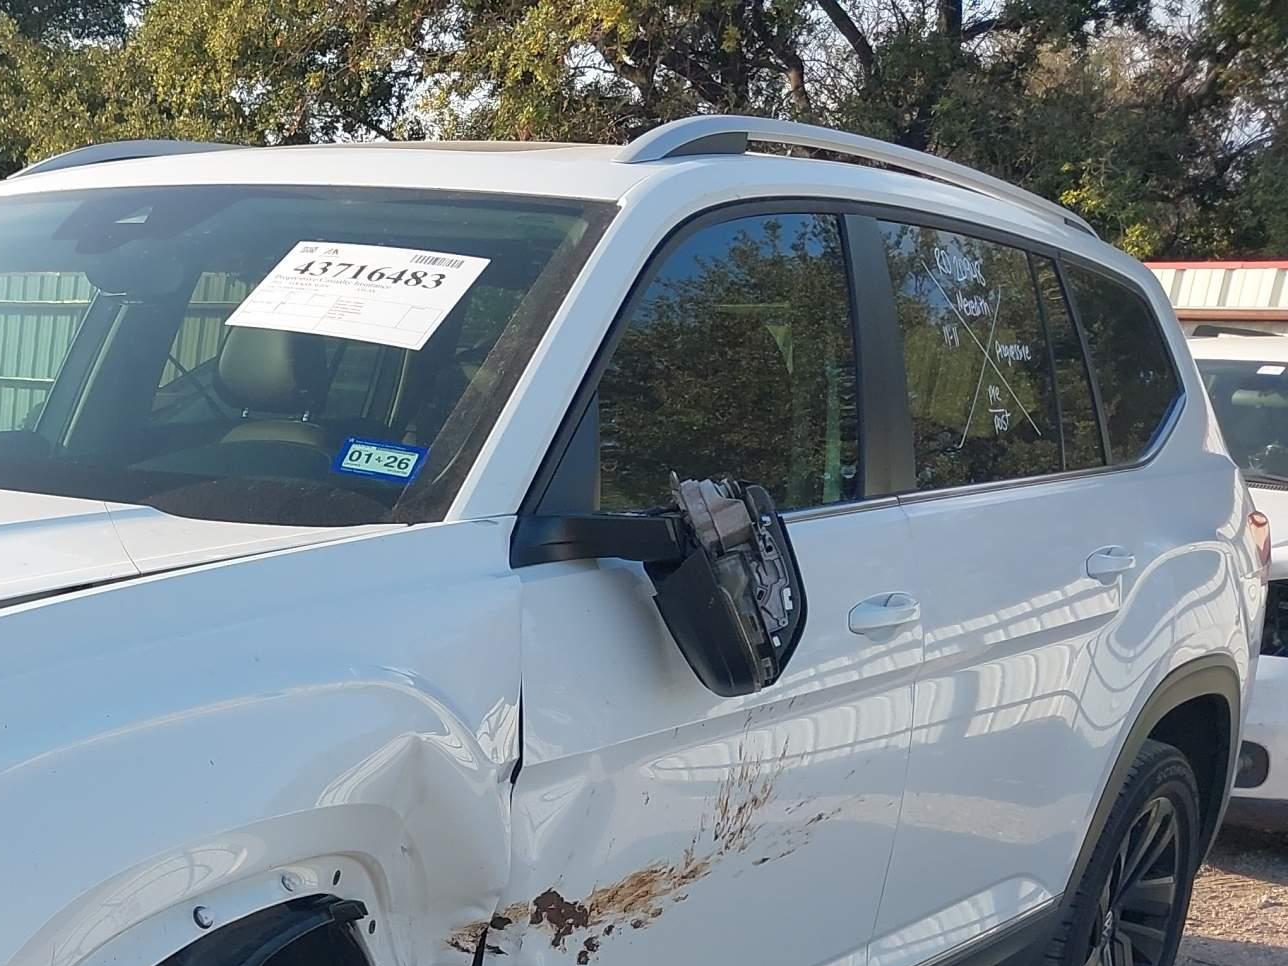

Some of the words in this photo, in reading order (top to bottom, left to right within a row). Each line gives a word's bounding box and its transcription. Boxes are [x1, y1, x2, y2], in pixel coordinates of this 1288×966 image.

[293, 260, 446, 289] 43716483
[348, 450, 373, 465] 01
[383, 456, 411, 470] 26
